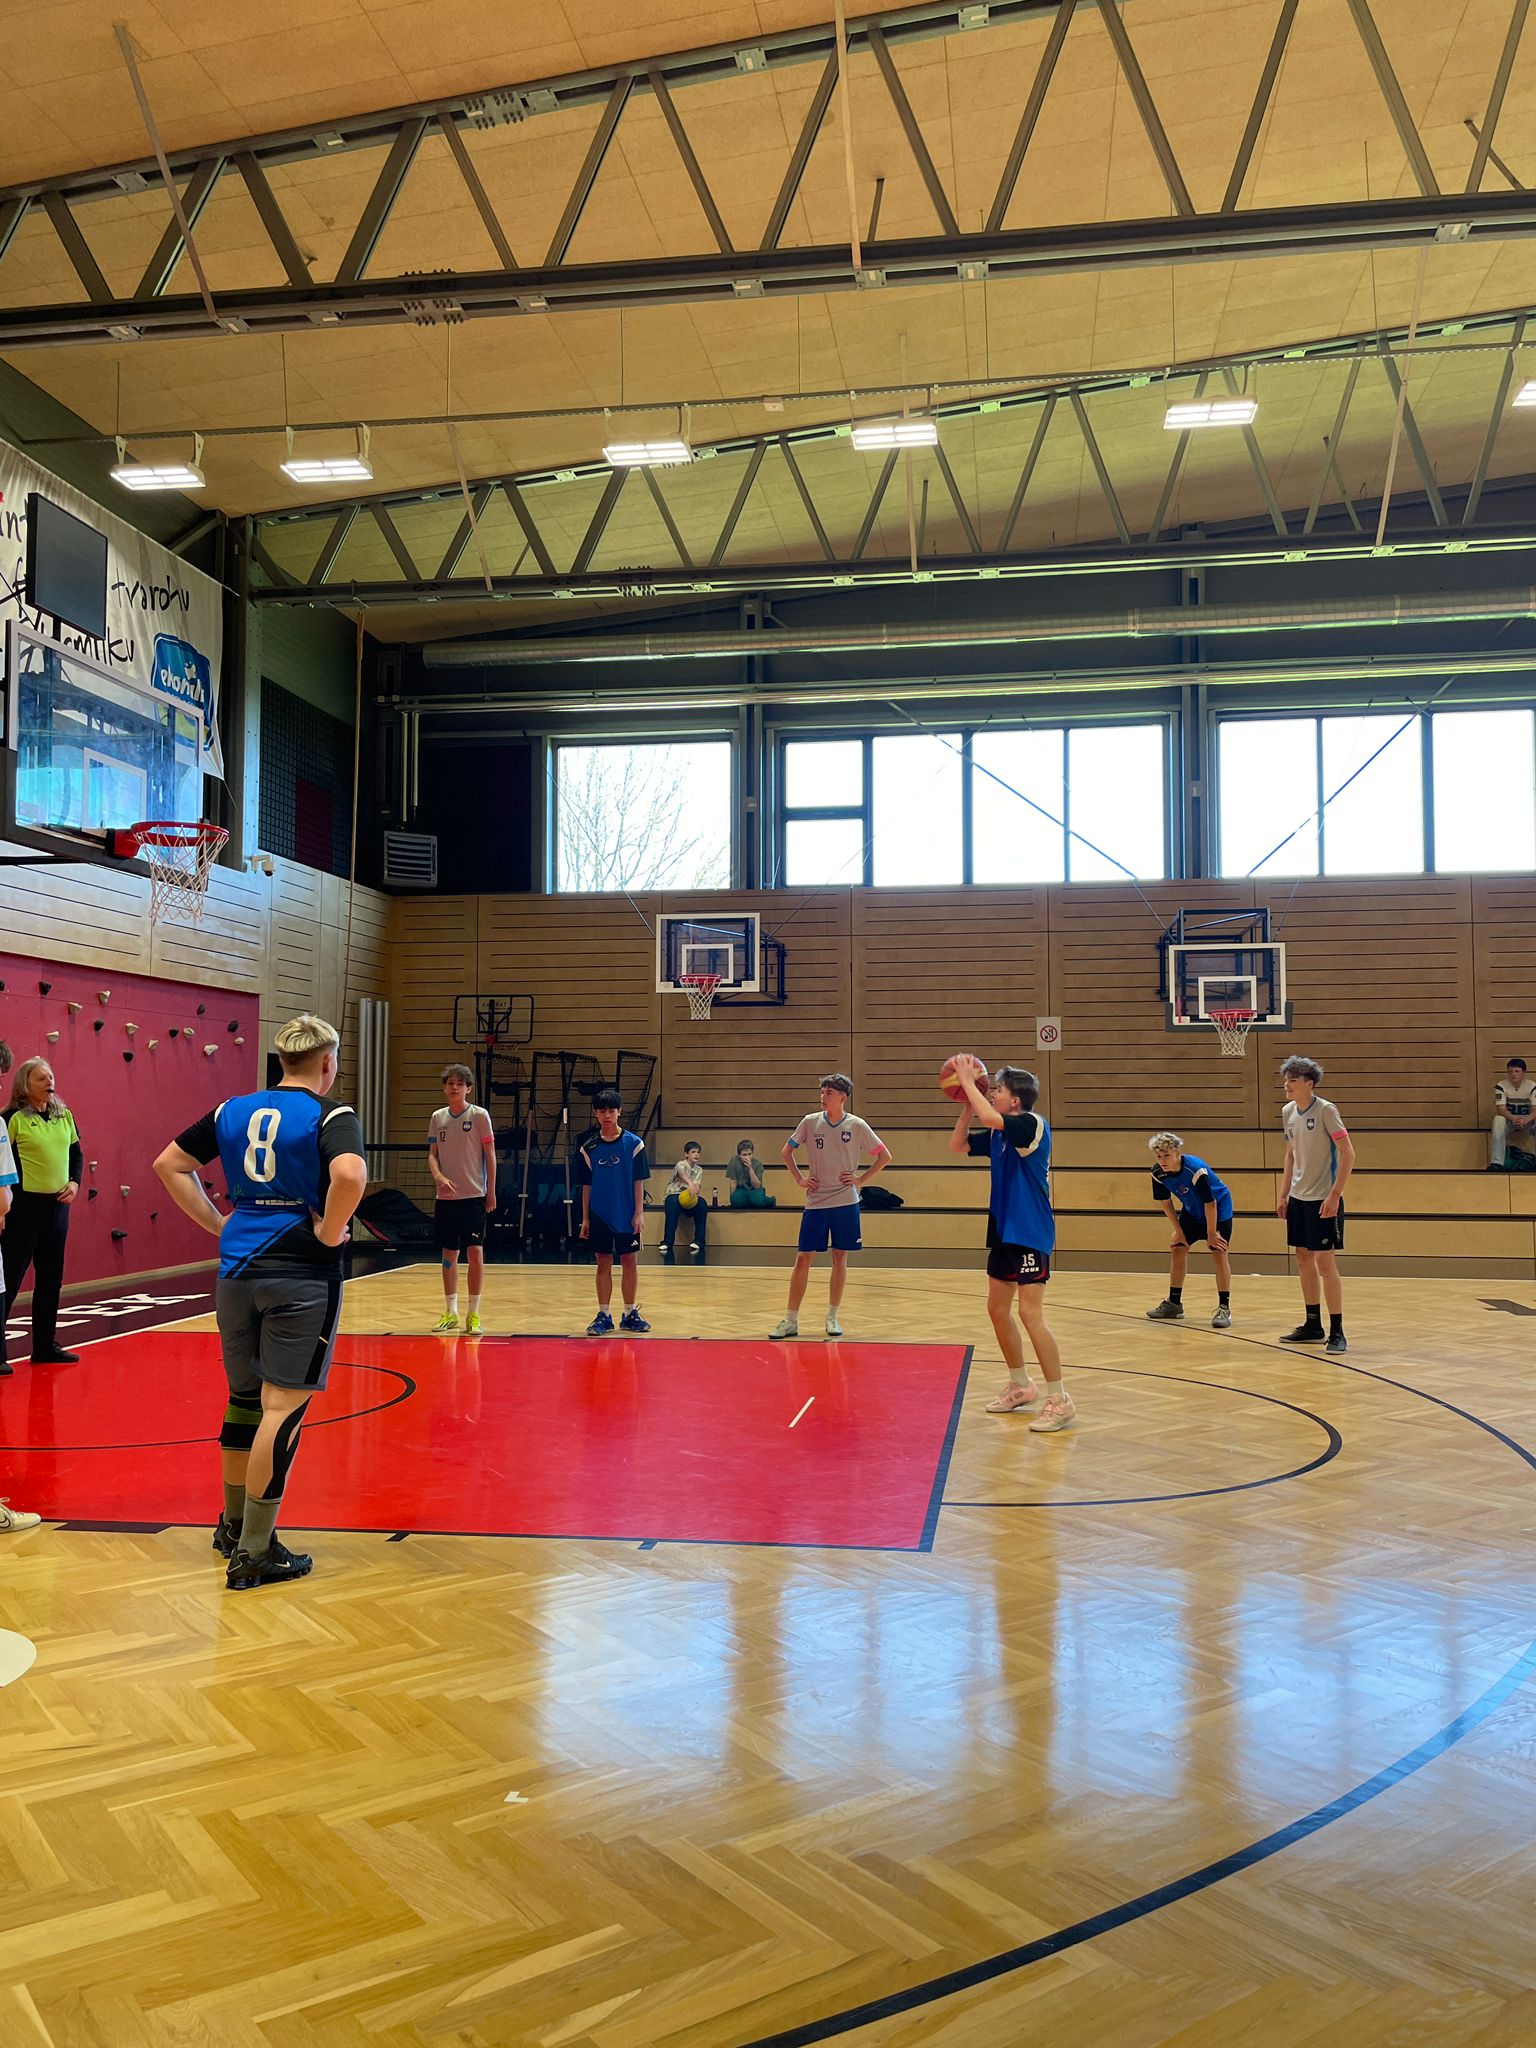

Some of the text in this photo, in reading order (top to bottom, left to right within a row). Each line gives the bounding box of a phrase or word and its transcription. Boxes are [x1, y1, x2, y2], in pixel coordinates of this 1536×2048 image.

[243, 1108, 282, 1183] 8
[815, 1137, 824, 1150] 19
[1022, 1253, 1036, 1267] 15
